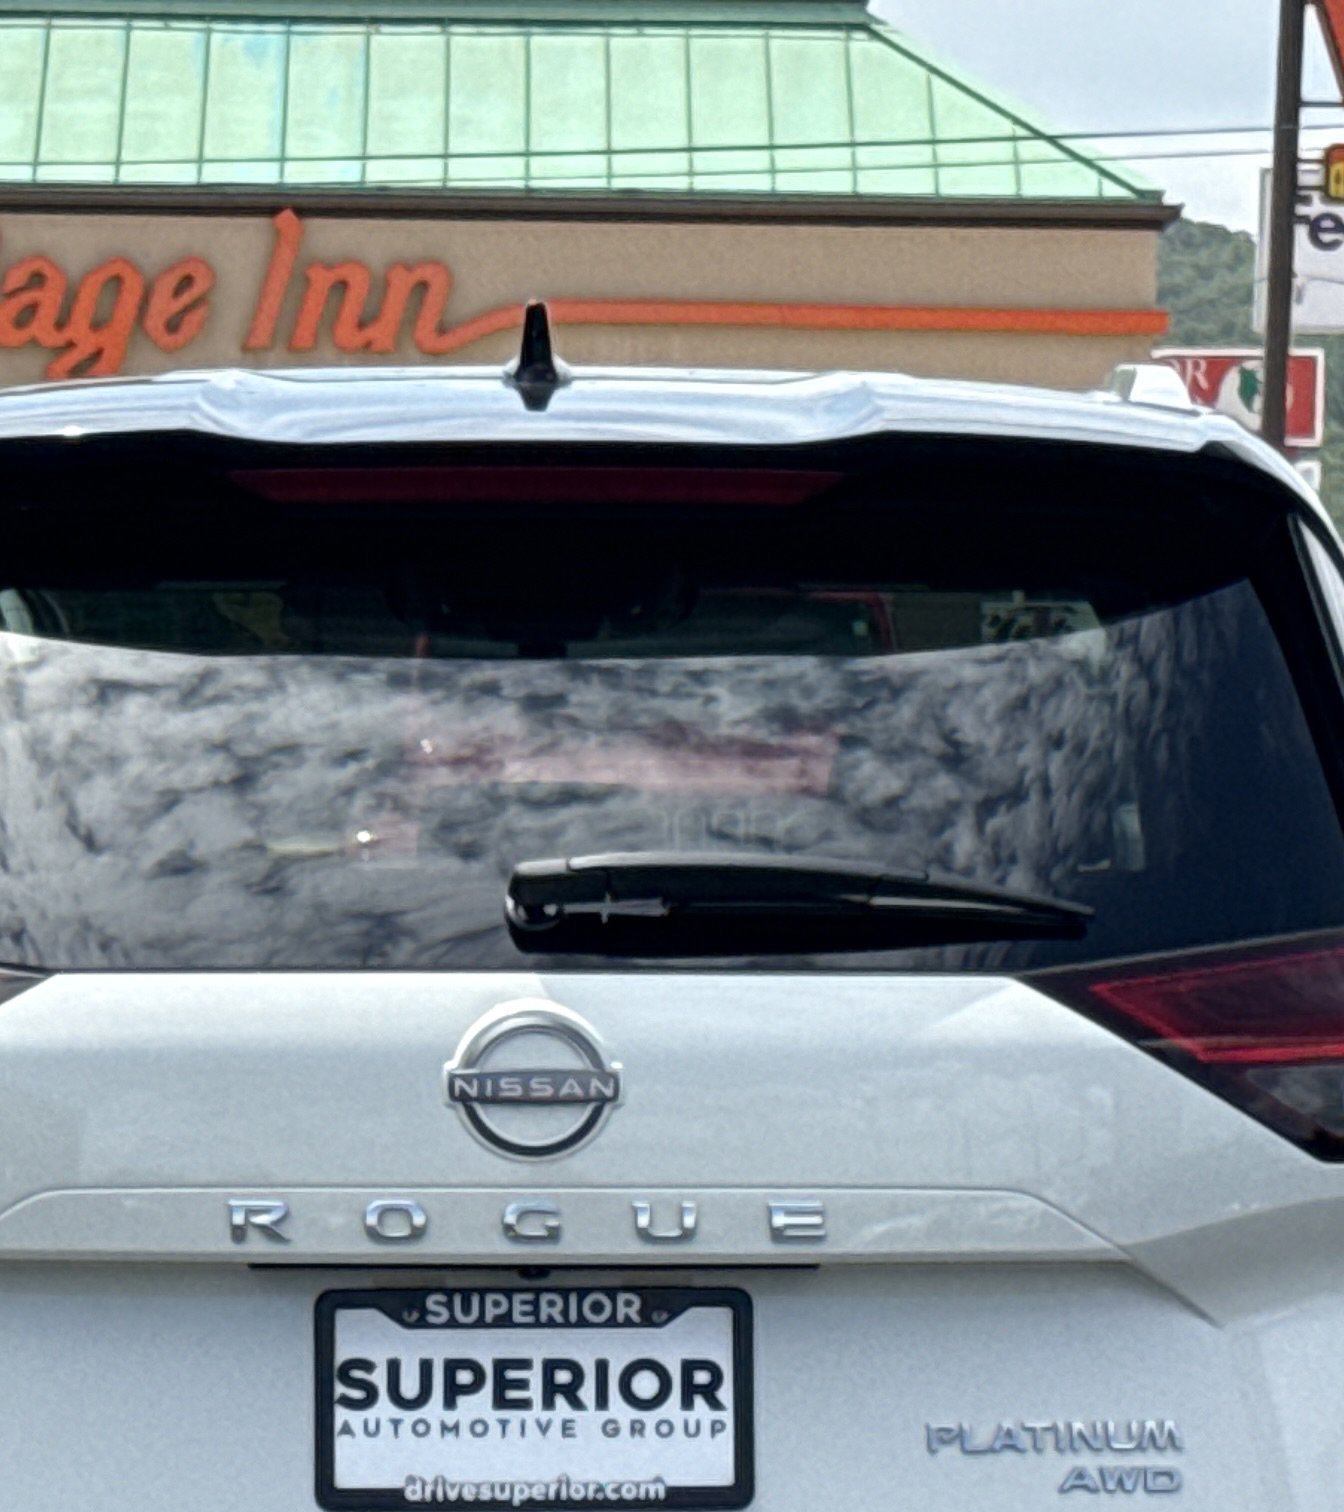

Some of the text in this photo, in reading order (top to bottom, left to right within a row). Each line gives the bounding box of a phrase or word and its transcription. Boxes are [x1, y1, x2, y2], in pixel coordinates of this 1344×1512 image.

[244, 208, 459, 355] Inn
[453, 1077, 615, 1098] NISSAN
[227, 1199, 828, 1243] ROGUE
[425, 1292, 641, 1325] SUPERIOR
[334, 1357, 727, 1412] SUPERIOR
[336, 1417, 728, 1440] AUTOMOTIVE GROUP
[925, 1419, 1184, 1456] PLATINUM
[403, 1474, 666, 1507] drivesuperior.com
[1057, 1464, 1183, 1494] AWD
